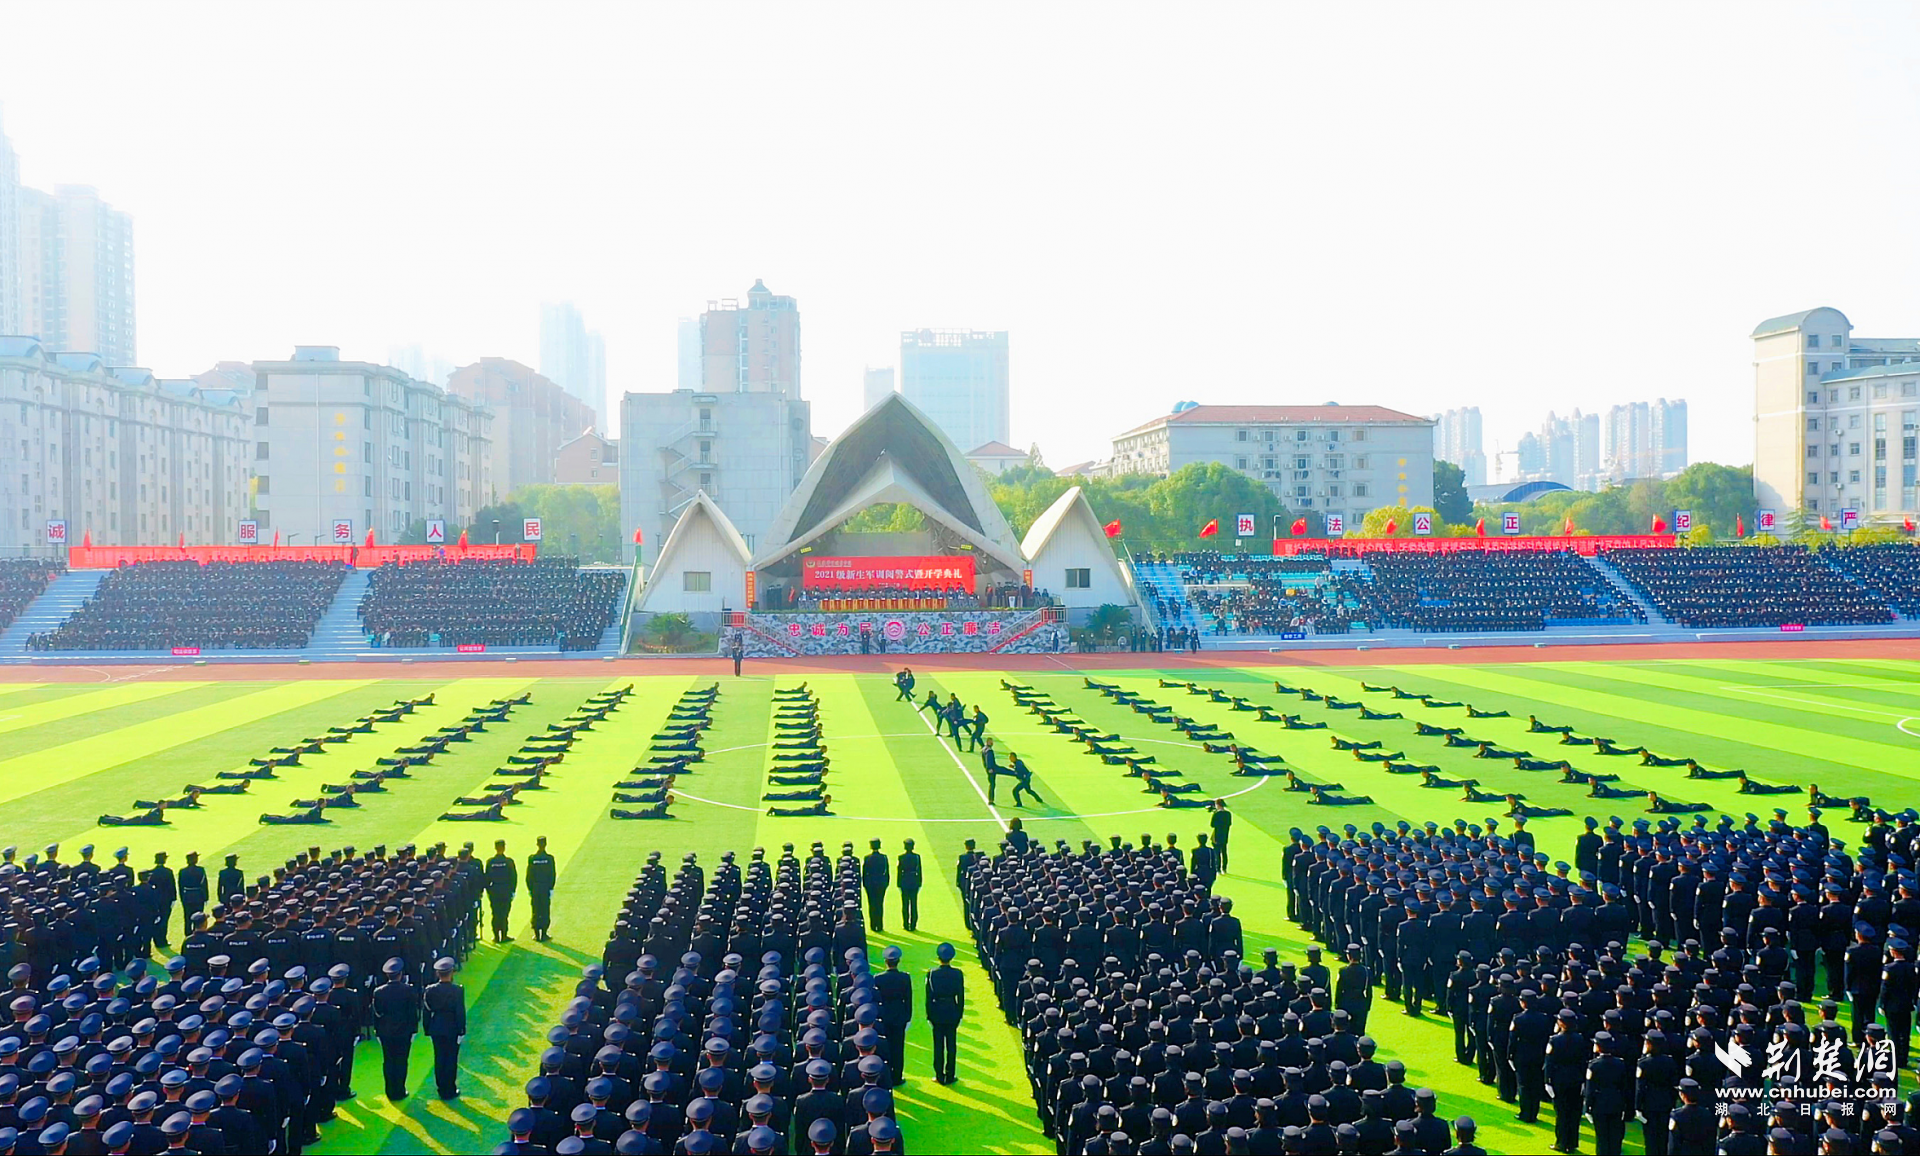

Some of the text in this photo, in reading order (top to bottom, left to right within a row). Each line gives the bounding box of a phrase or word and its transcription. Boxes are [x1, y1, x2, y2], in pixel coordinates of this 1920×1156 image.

[1239, 518, 1253, 532] 执
[1328, 518, 1342, 532] 法
[1416, 517, 1430, 531] 公
[1505, 516, 1518, 530] 正
[1677, 515, 1690, 528] 纪
[1761, 513, 1774, 527] 律
[48, 524, 64, 539] 诚
[240, 524, 256, 539] 服
[334, 523, 350, 539] 务
[428, 523, 442, 539] 人
[525, 522, 540, 537] 民
